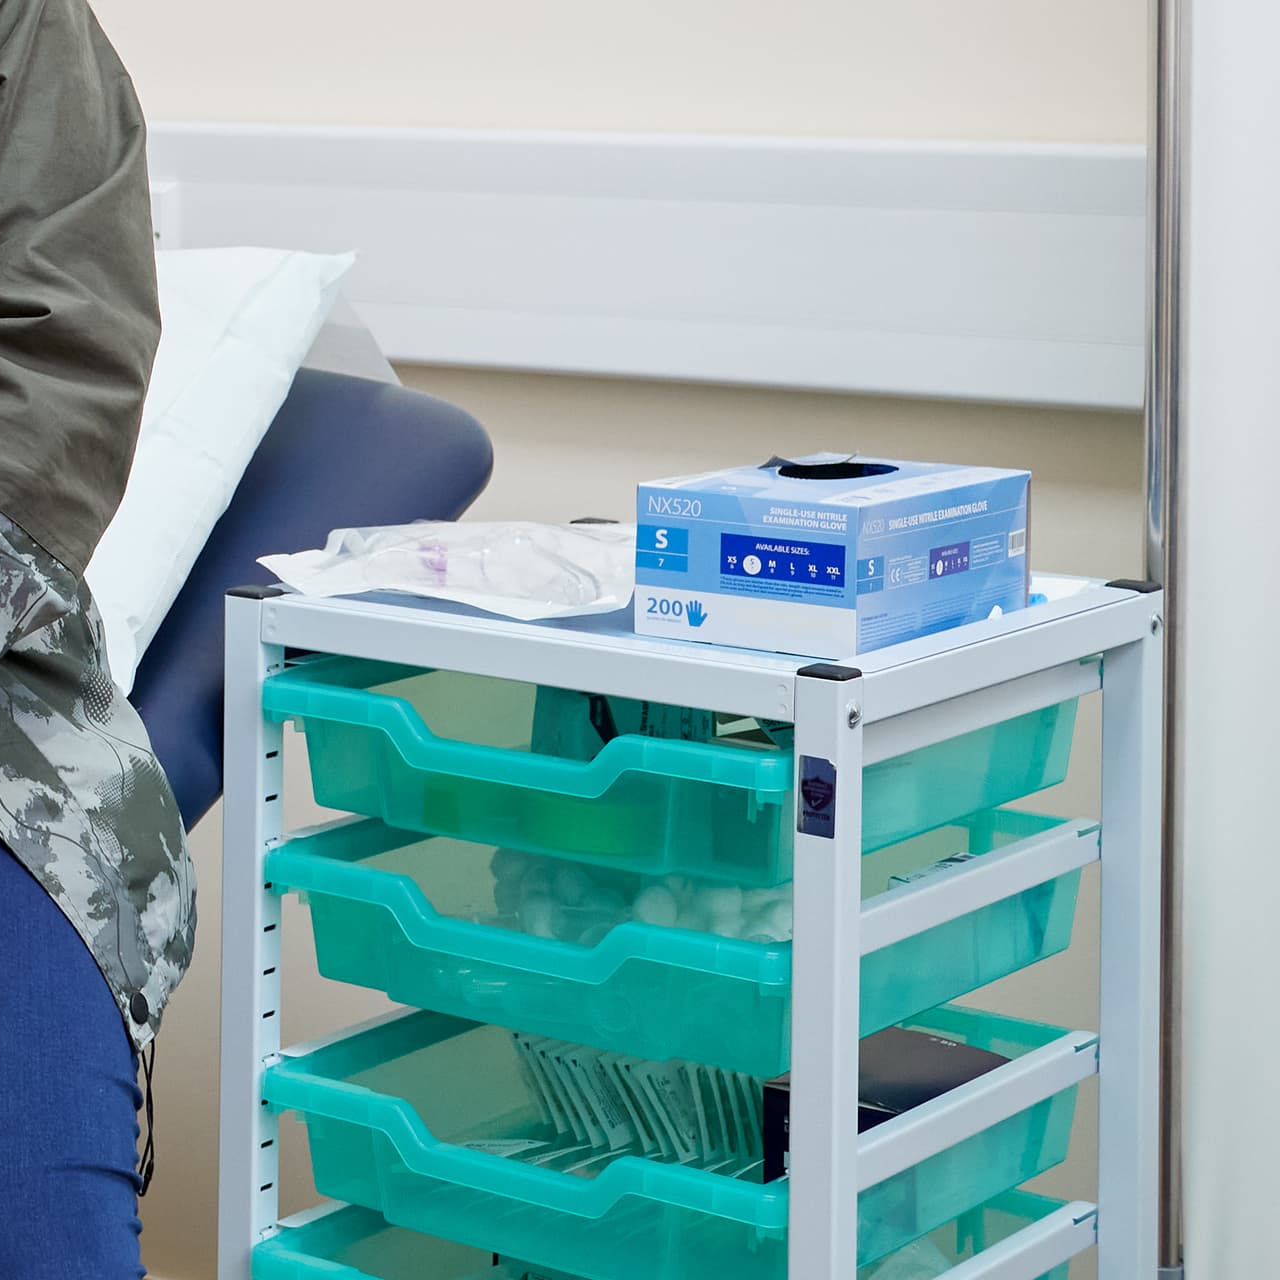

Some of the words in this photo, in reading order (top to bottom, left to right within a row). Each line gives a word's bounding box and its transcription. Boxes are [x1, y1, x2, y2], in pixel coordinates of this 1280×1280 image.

[647, 495, 702, 517] NX520
[769, 506, 816, 518] SINGLE-USE
[817, 510, 848, 523] NITRILE
[888, 516, 919, 531] SINGLE-USE
[918, 510, 939, 525] NITRILE
[938, 504, 972, 521] EXAMINATION
[971, 500, 989, 513] GLOVE
[762, 514, 820, 530] EXAMINATION
[819, 519, 848, 532] GLOVE
[655, 528, 668, 549] S
[755, 542, 790, 554] AVAILABLE
[790, 547, 811, 556] SIZES:
[658, 558, 665, 568] 7
[727, 555, 738, 564] XS
[768, 559, 777, 569] M
[790, 562, 795, 571] L
[808, 564, 818, 573] XL
[826, 565, 841, 576] XXL
[868, 559, 875, 577] S
[646, 597, 683, 617] 200
